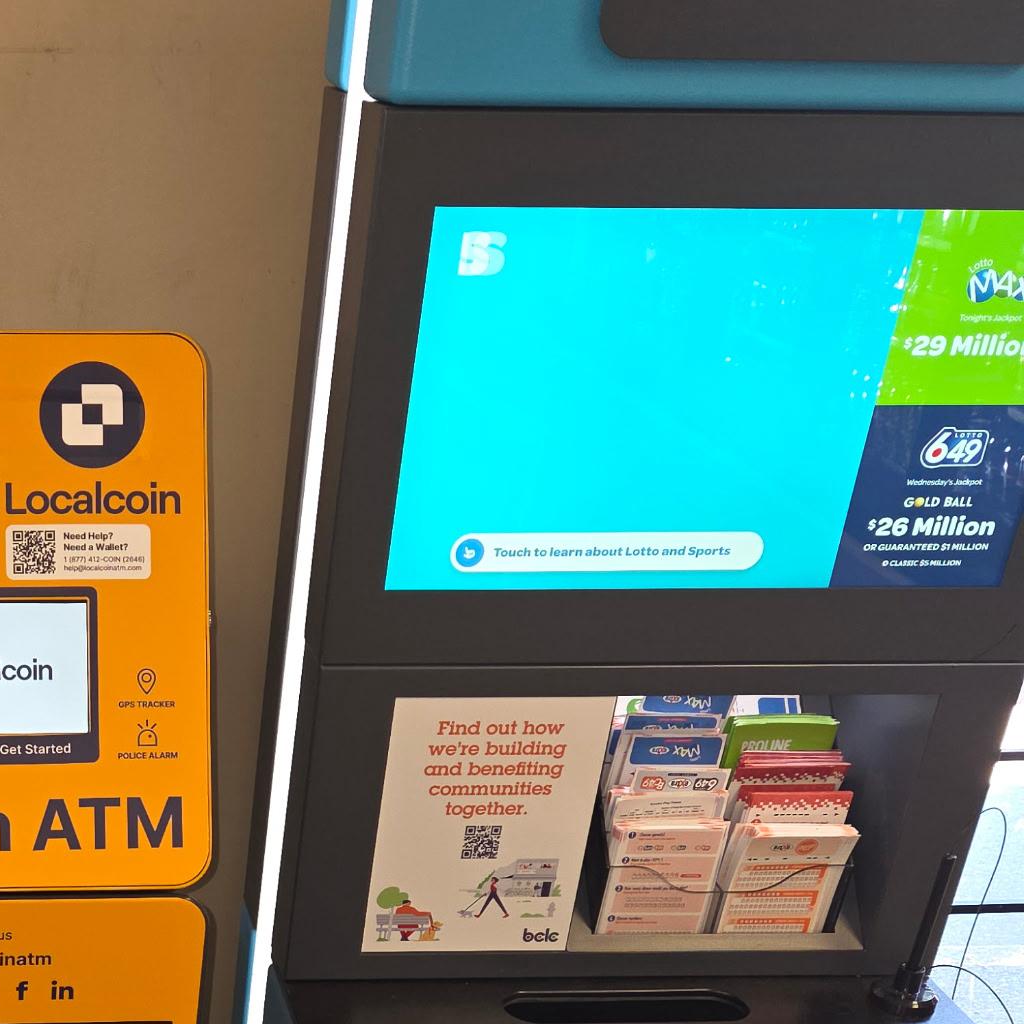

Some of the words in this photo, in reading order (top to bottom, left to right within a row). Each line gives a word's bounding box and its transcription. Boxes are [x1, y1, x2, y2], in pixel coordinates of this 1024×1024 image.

[968, 257, 994, 274] Lotto
[959, 313, 993, 323] Tonight's
[993, 313, 1023, 323] Jackpot
[903, 335, 947, 357] $29
[949, 332, 1024, 357] Millio
[906, 478, 953, 487] Wednesday's
[953, 478, 983, 487] Jackpot
[5, 480, 182, 515] Localcoin
[903, 496, 941, 508] GOLD
[943, 496, 973, 507] BALL
[867, 517, 910, 537] $26
[912, 514, 996, 536] Million
[63, 532, 86, 540] Need
[88, 532, 114, 541] Help?
[63, 543, 86, 551] Need
[95, 543, 129, 551] Wallet?
[494, 546, 532, 557] Touch
[534, 547, 547, 557] to
[549, 546, 583, 557] learn
[585, 546, 623, 557] about
[625, 546, 660, 557] Lotto
[662, 546, 686, 556] and
[687, 545, 731, 558] Sports
[877, 543, 940, 551] GUARANTEED
[940, 543, 951, 552] $1
[951, 543, 989, 551] MILLION
[69, 556, 87, 564] (877)
[122, 556, 145, 564] (2646)
[889, 559, 919, 567] CLASSIC
[919, 559, 930, 567] $5
[930, 559, 962, 567] MILLION
[63, 564, 143, 572] help@localcoinatm.com
[118, 701, 135, 709] GPS
[137, 700, 176, 708] TRACKER
[437, 720, 481, 736] Find
[486, 721, 518, 736] out
[522, 720, 566, 736] how
[0, 743, 22, 755] Get
[24, 742, 71, 755] Started
[428, 742, 480, 756] we're
[485, 741, 568, 759] building
[741, 739, 792, 751] PROLINE
[118, 752, 148, 760] POLICE
[149, 751, 179, 760] ALARM
[424, 762, 463, 776] and
[467, 761, 565, 779] benefiting
[429, 782, 553, 796] communities
[445, 802, 528, 819] together.
[32, 795, 184, 852] ATM
[522, 928, 559, 942] bclc
